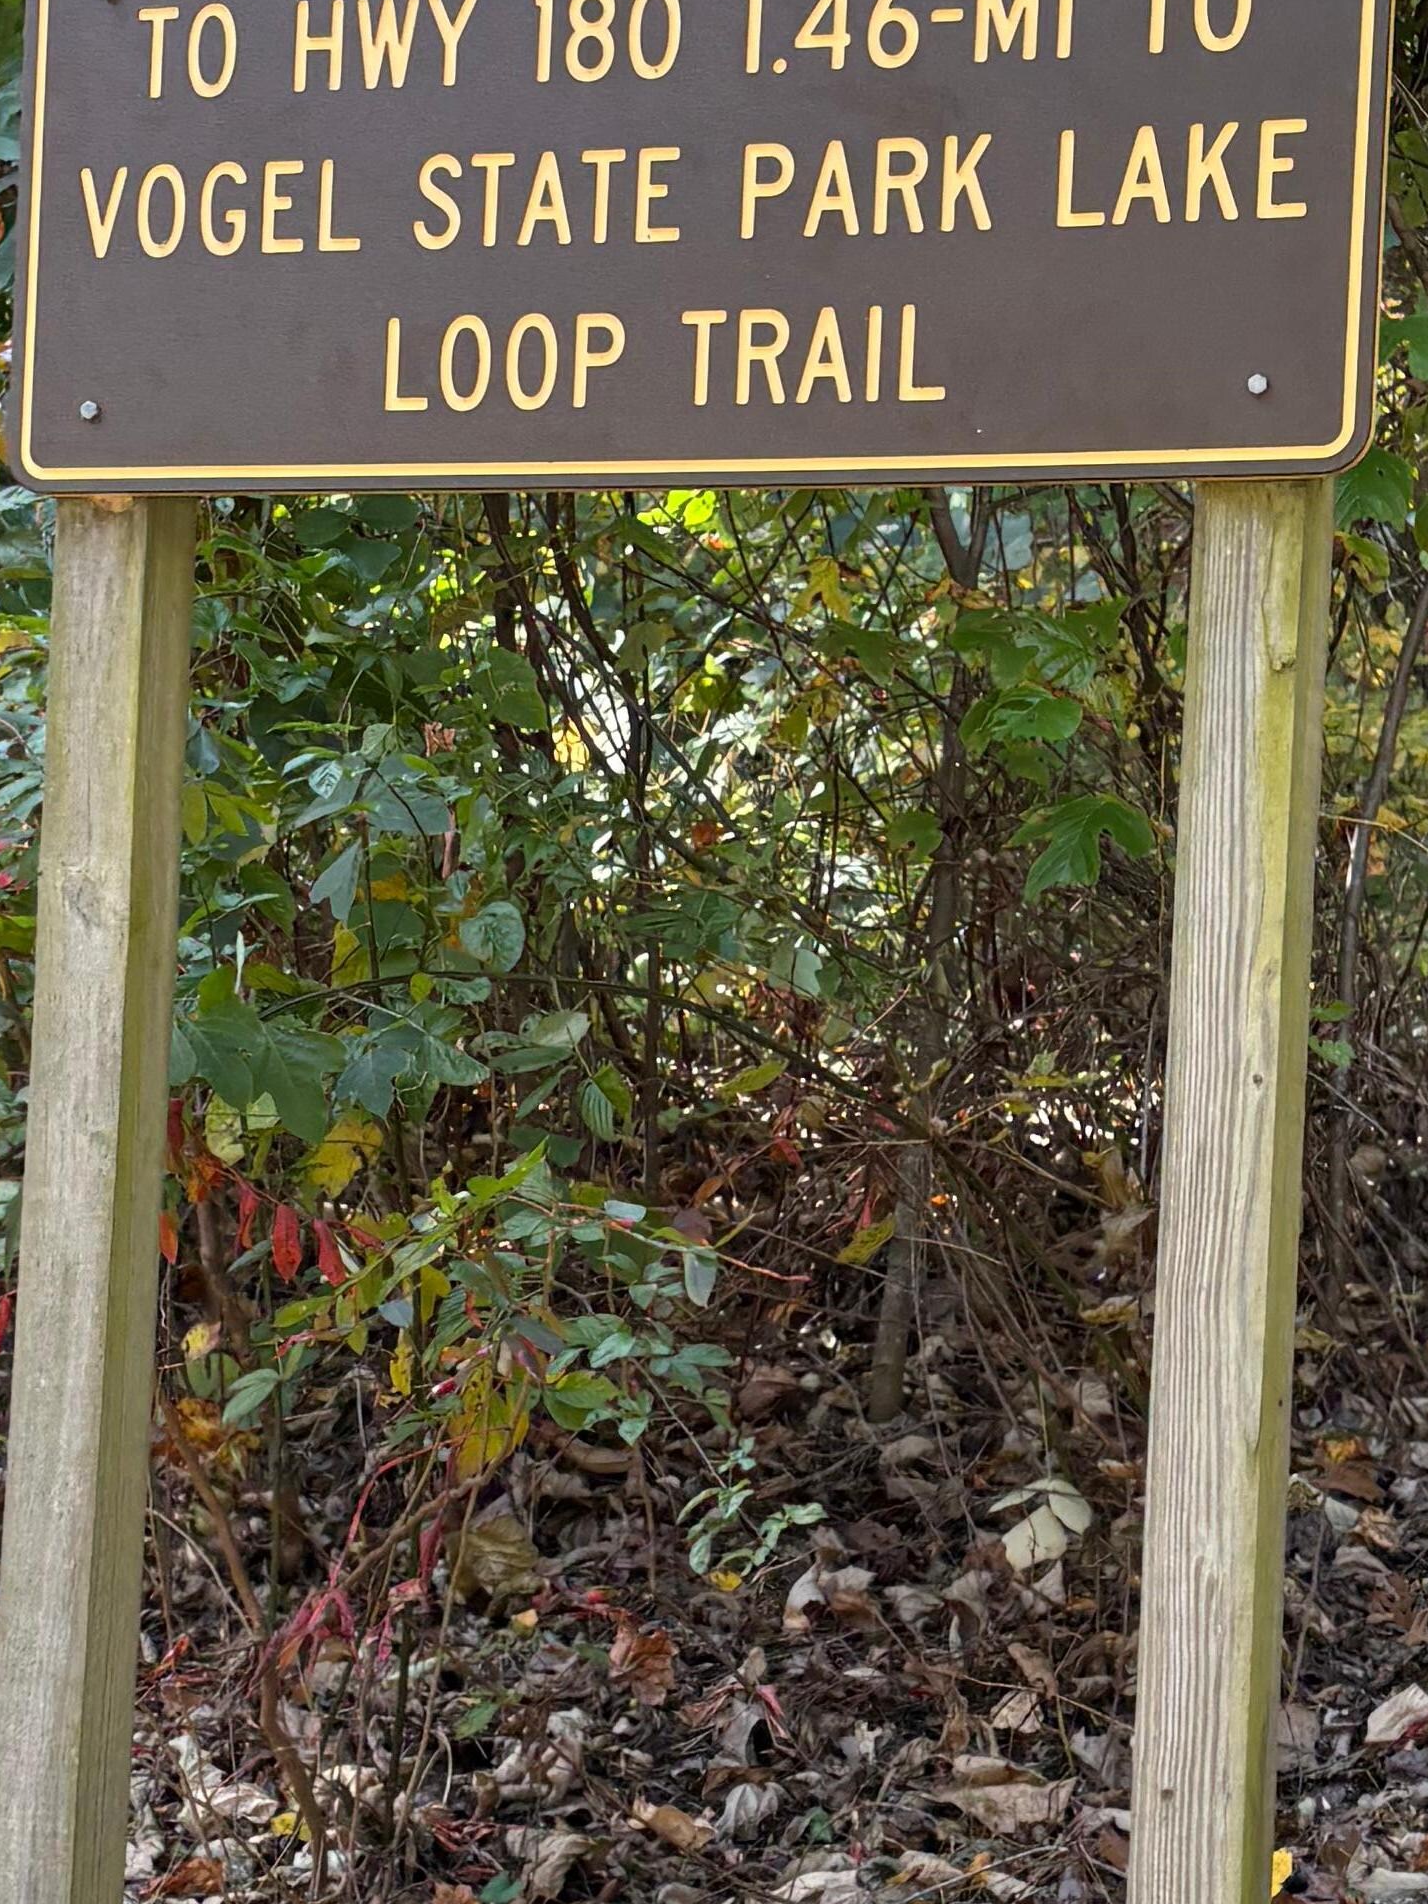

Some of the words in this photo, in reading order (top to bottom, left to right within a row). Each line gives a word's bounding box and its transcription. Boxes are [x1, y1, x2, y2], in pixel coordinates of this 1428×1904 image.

[139, 3, 236, 98] TO
[81, 159, 360, 258] VOGEL
[414, 147, 680, 249] STATE
[741, 134, 991, 239] PARK
[1057, 119, 1307, 227] LAKE
[385, 313, 625, 411] LOOP
[682, 304, 945, 405] TRAIL
